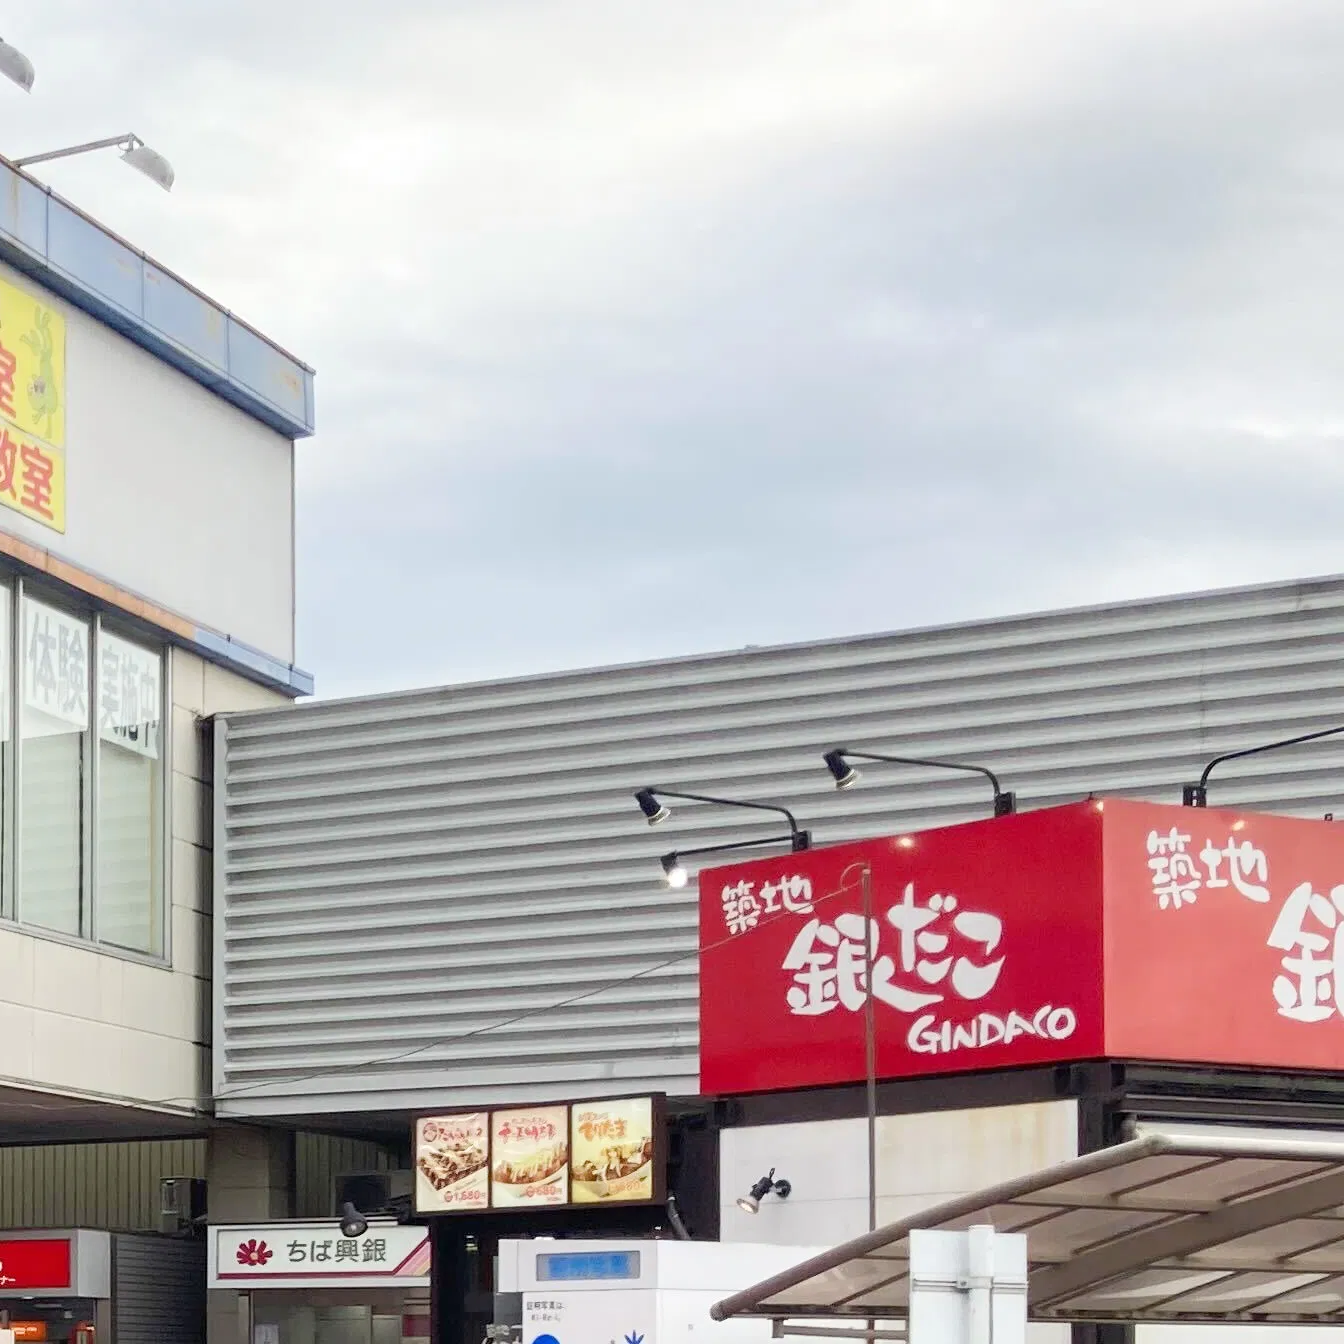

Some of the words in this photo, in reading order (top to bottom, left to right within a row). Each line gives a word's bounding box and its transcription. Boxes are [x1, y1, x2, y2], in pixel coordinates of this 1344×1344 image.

[1145, 825, 1272, 911] 築地
[721, 875, 815, 935] 築地
[781, 881, 1007, 1016] 銀だこ
[907, 1004, 1078, 1055] GINDACO
[286, 1238, 388, 1265] ちば興銀
